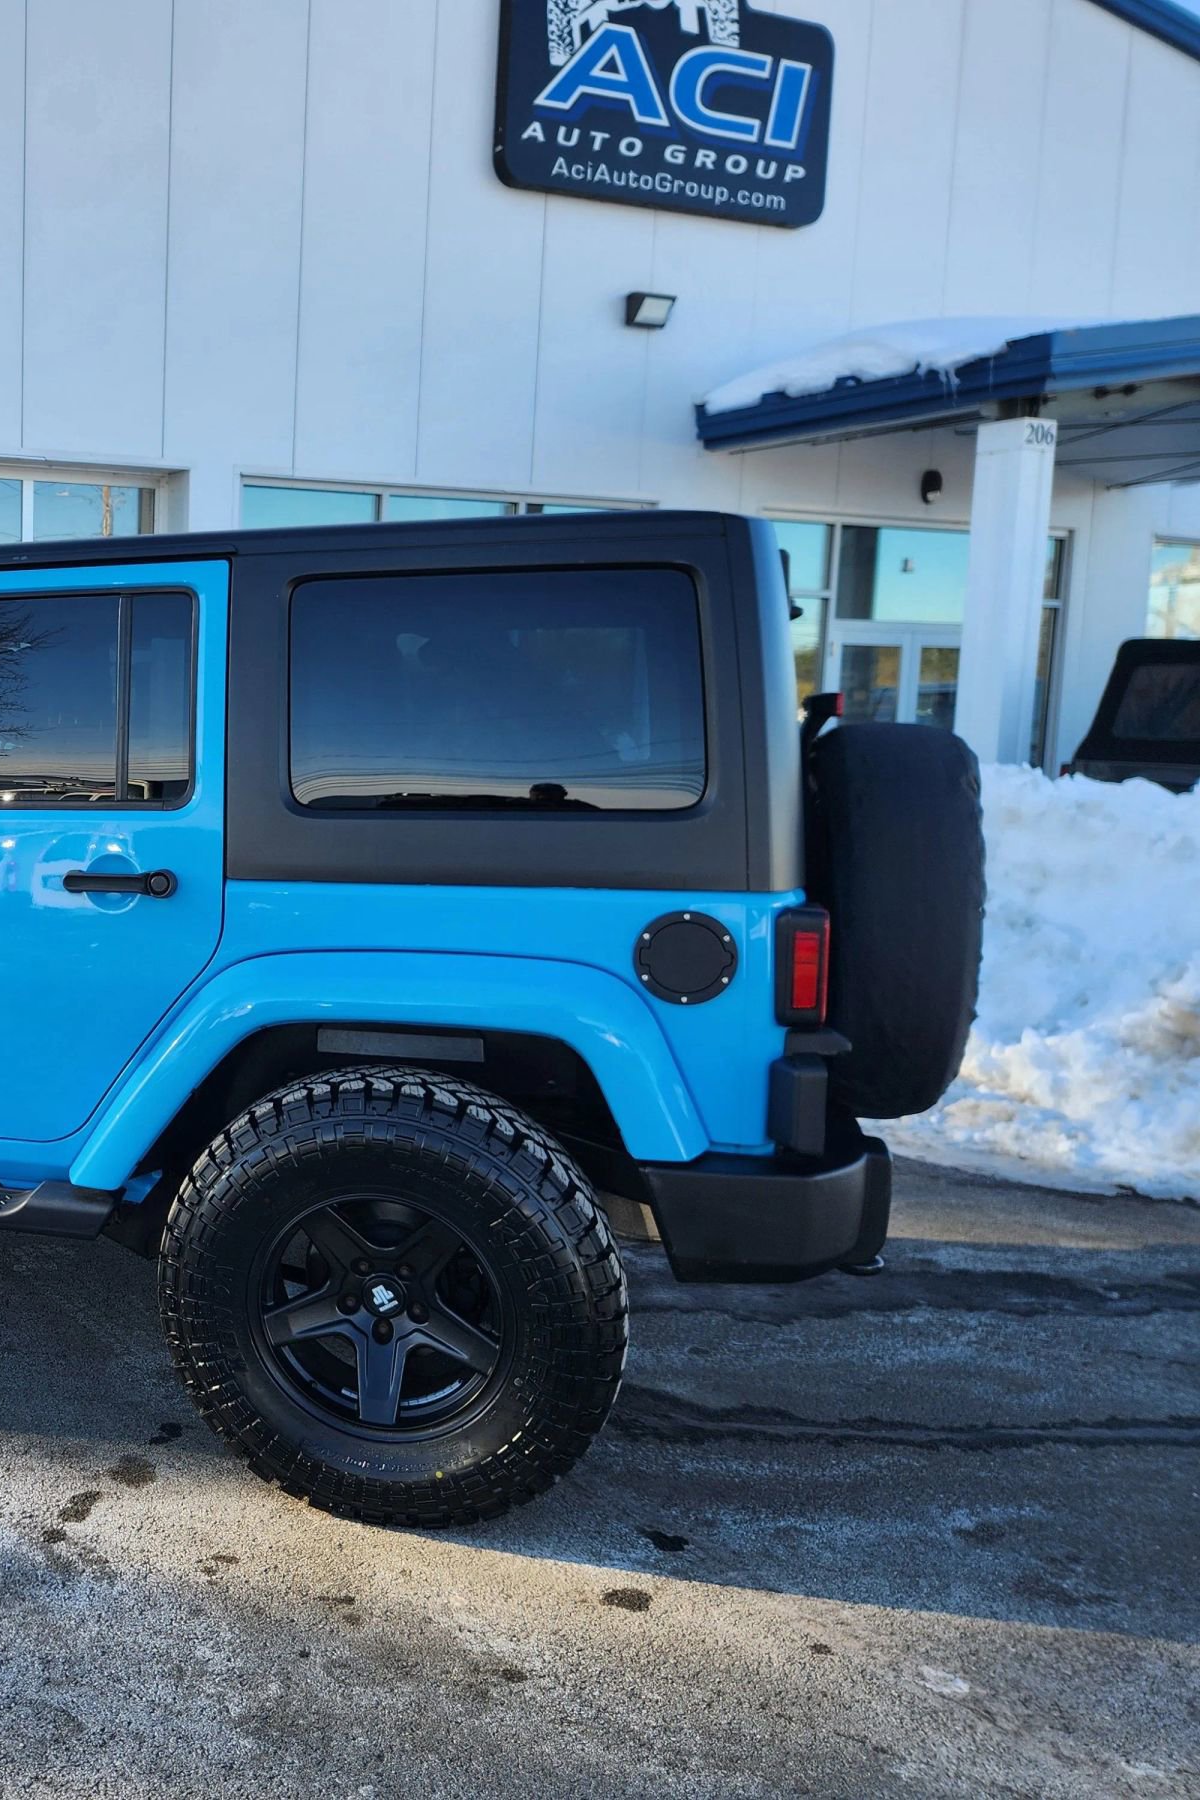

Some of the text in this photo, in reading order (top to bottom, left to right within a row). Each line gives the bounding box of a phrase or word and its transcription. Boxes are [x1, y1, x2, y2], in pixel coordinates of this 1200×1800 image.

[533, 22, 813, 150] ACI
[521, 121, 807, 183] AUTO GROUP
[551, 156, 787, 211] AciAutoGroup.com
[1023, 422, 1055, 445] 206
